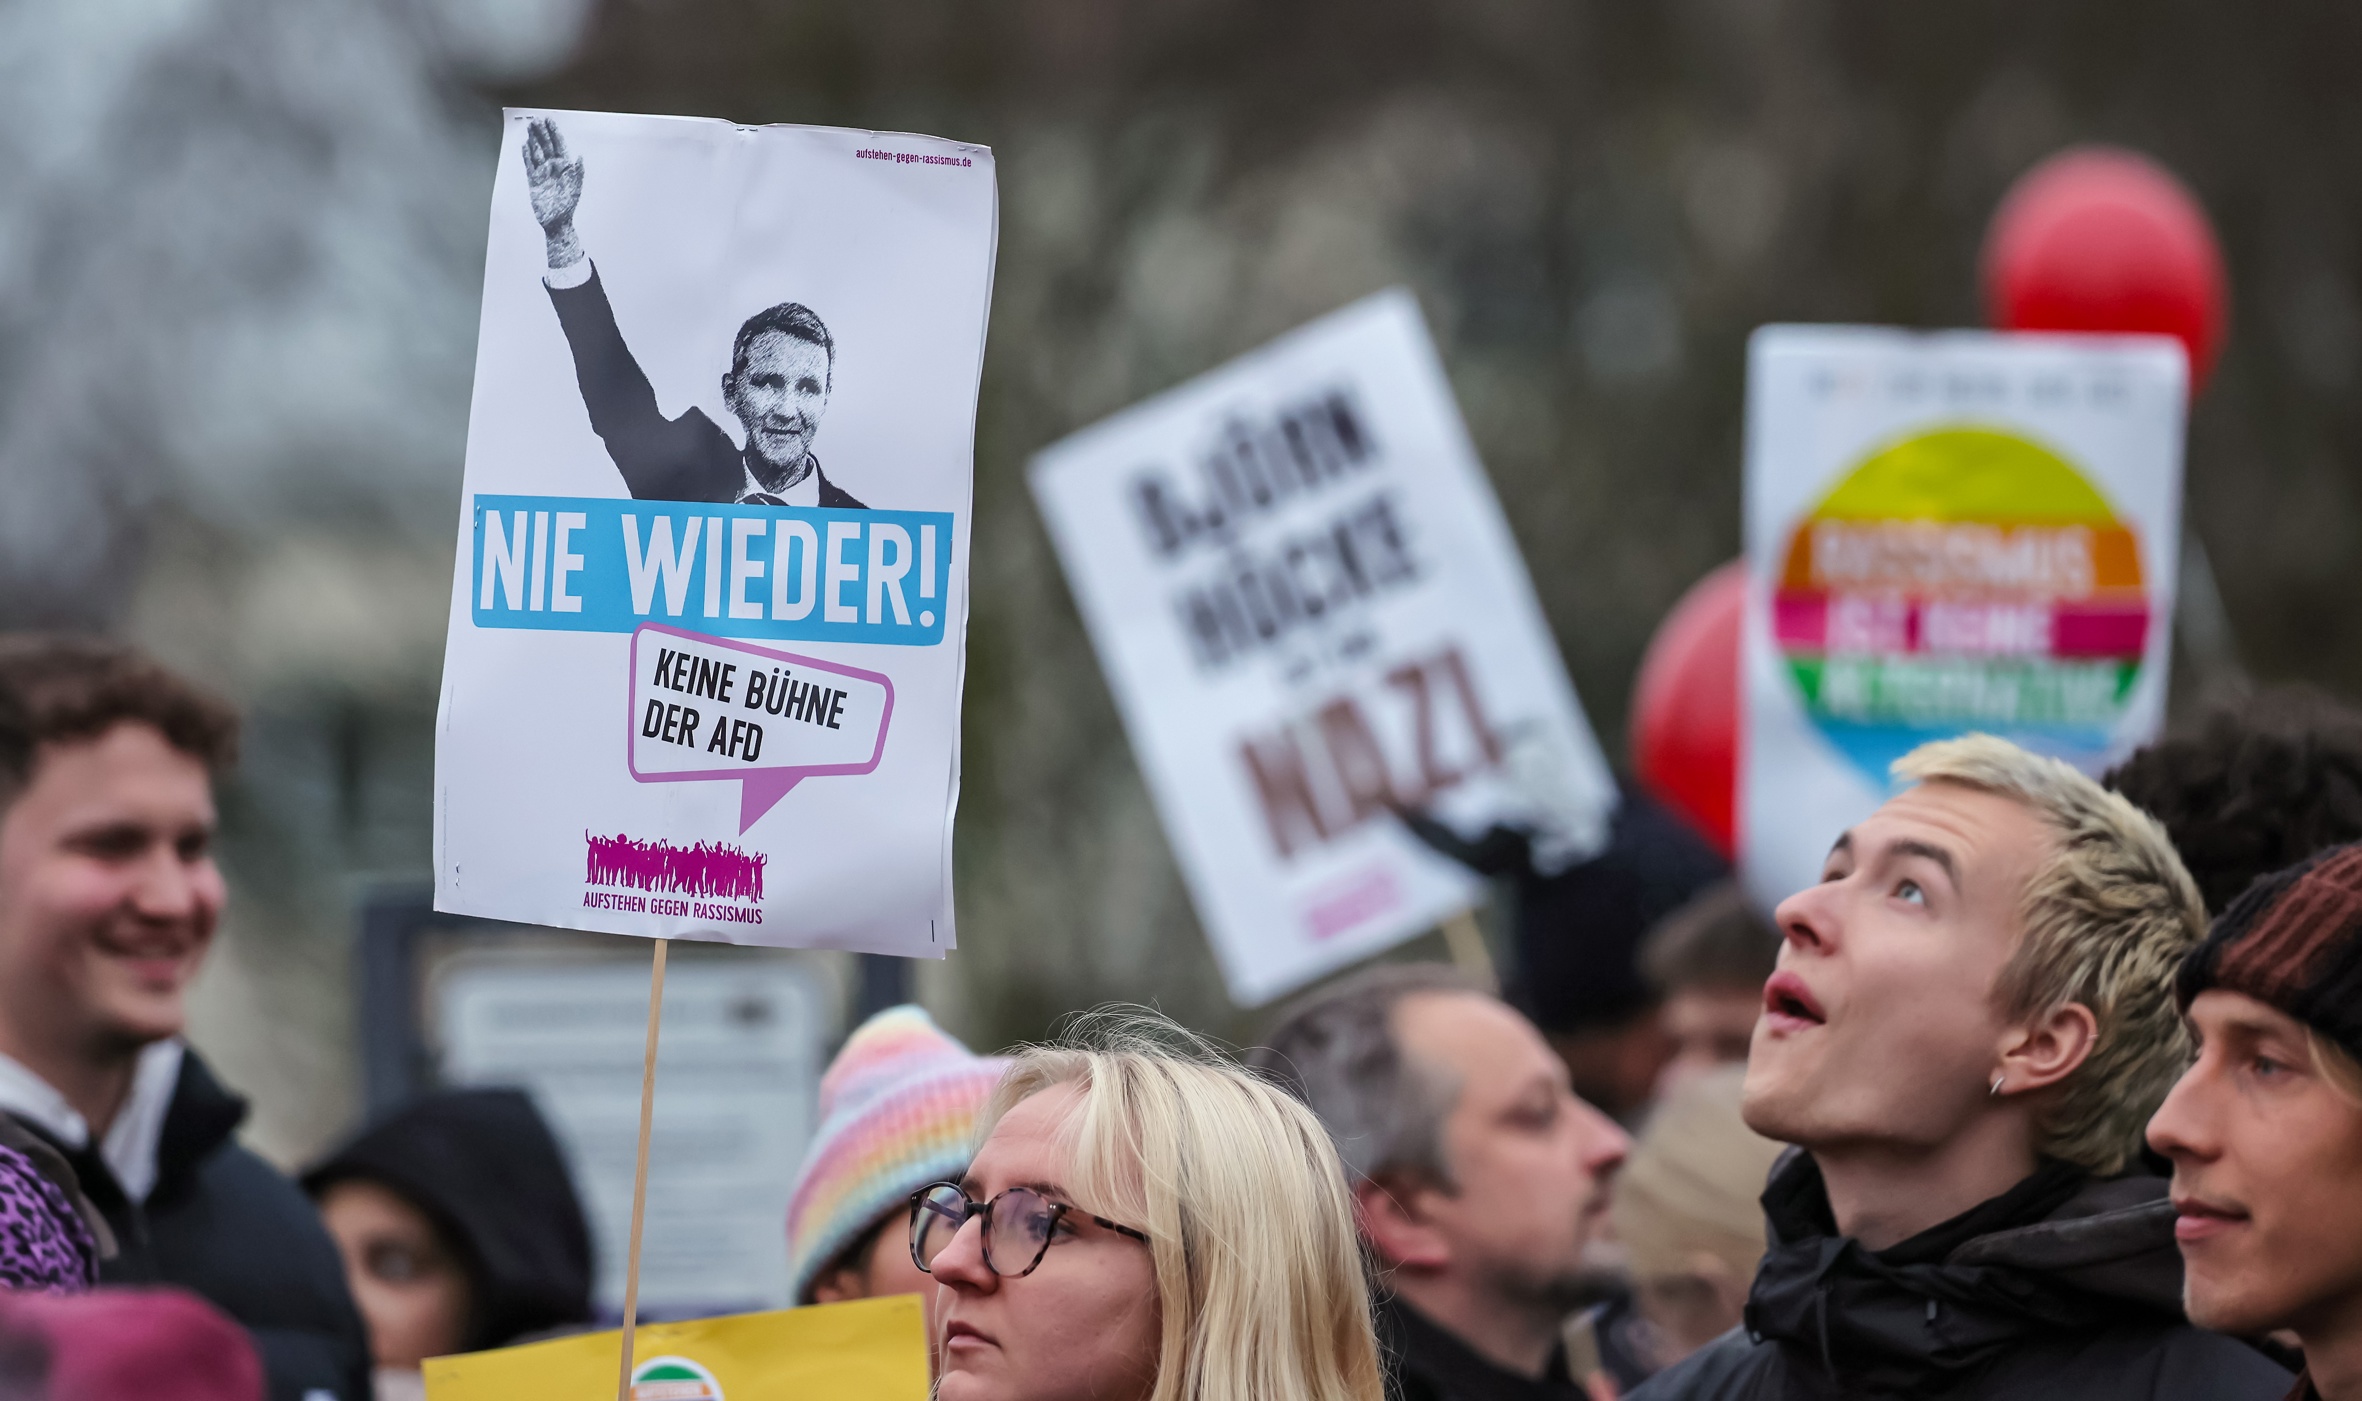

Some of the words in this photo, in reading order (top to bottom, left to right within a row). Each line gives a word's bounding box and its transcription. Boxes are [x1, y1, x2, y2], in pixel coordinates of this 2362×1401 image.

[855, 149, 972, 168] aufstehen-gegen-rassismus.de
[479, 509, 587, 613] NIE
[621, 512, 937, 628] WIEDER!
[653, 648, 738, 704] KEINE
[744, 667, 848, 730] BÜHNE
[641, 698, 701, 748] DER
[707, 716, 764, 763] AFD
[1236, 642, 1506, 860] NAZI
[583, 892, 646, 913] AUFSTEHEN
[650, 898, 689, 917] GEGEN
[693, 903, 763, 925] RASSISMUS
